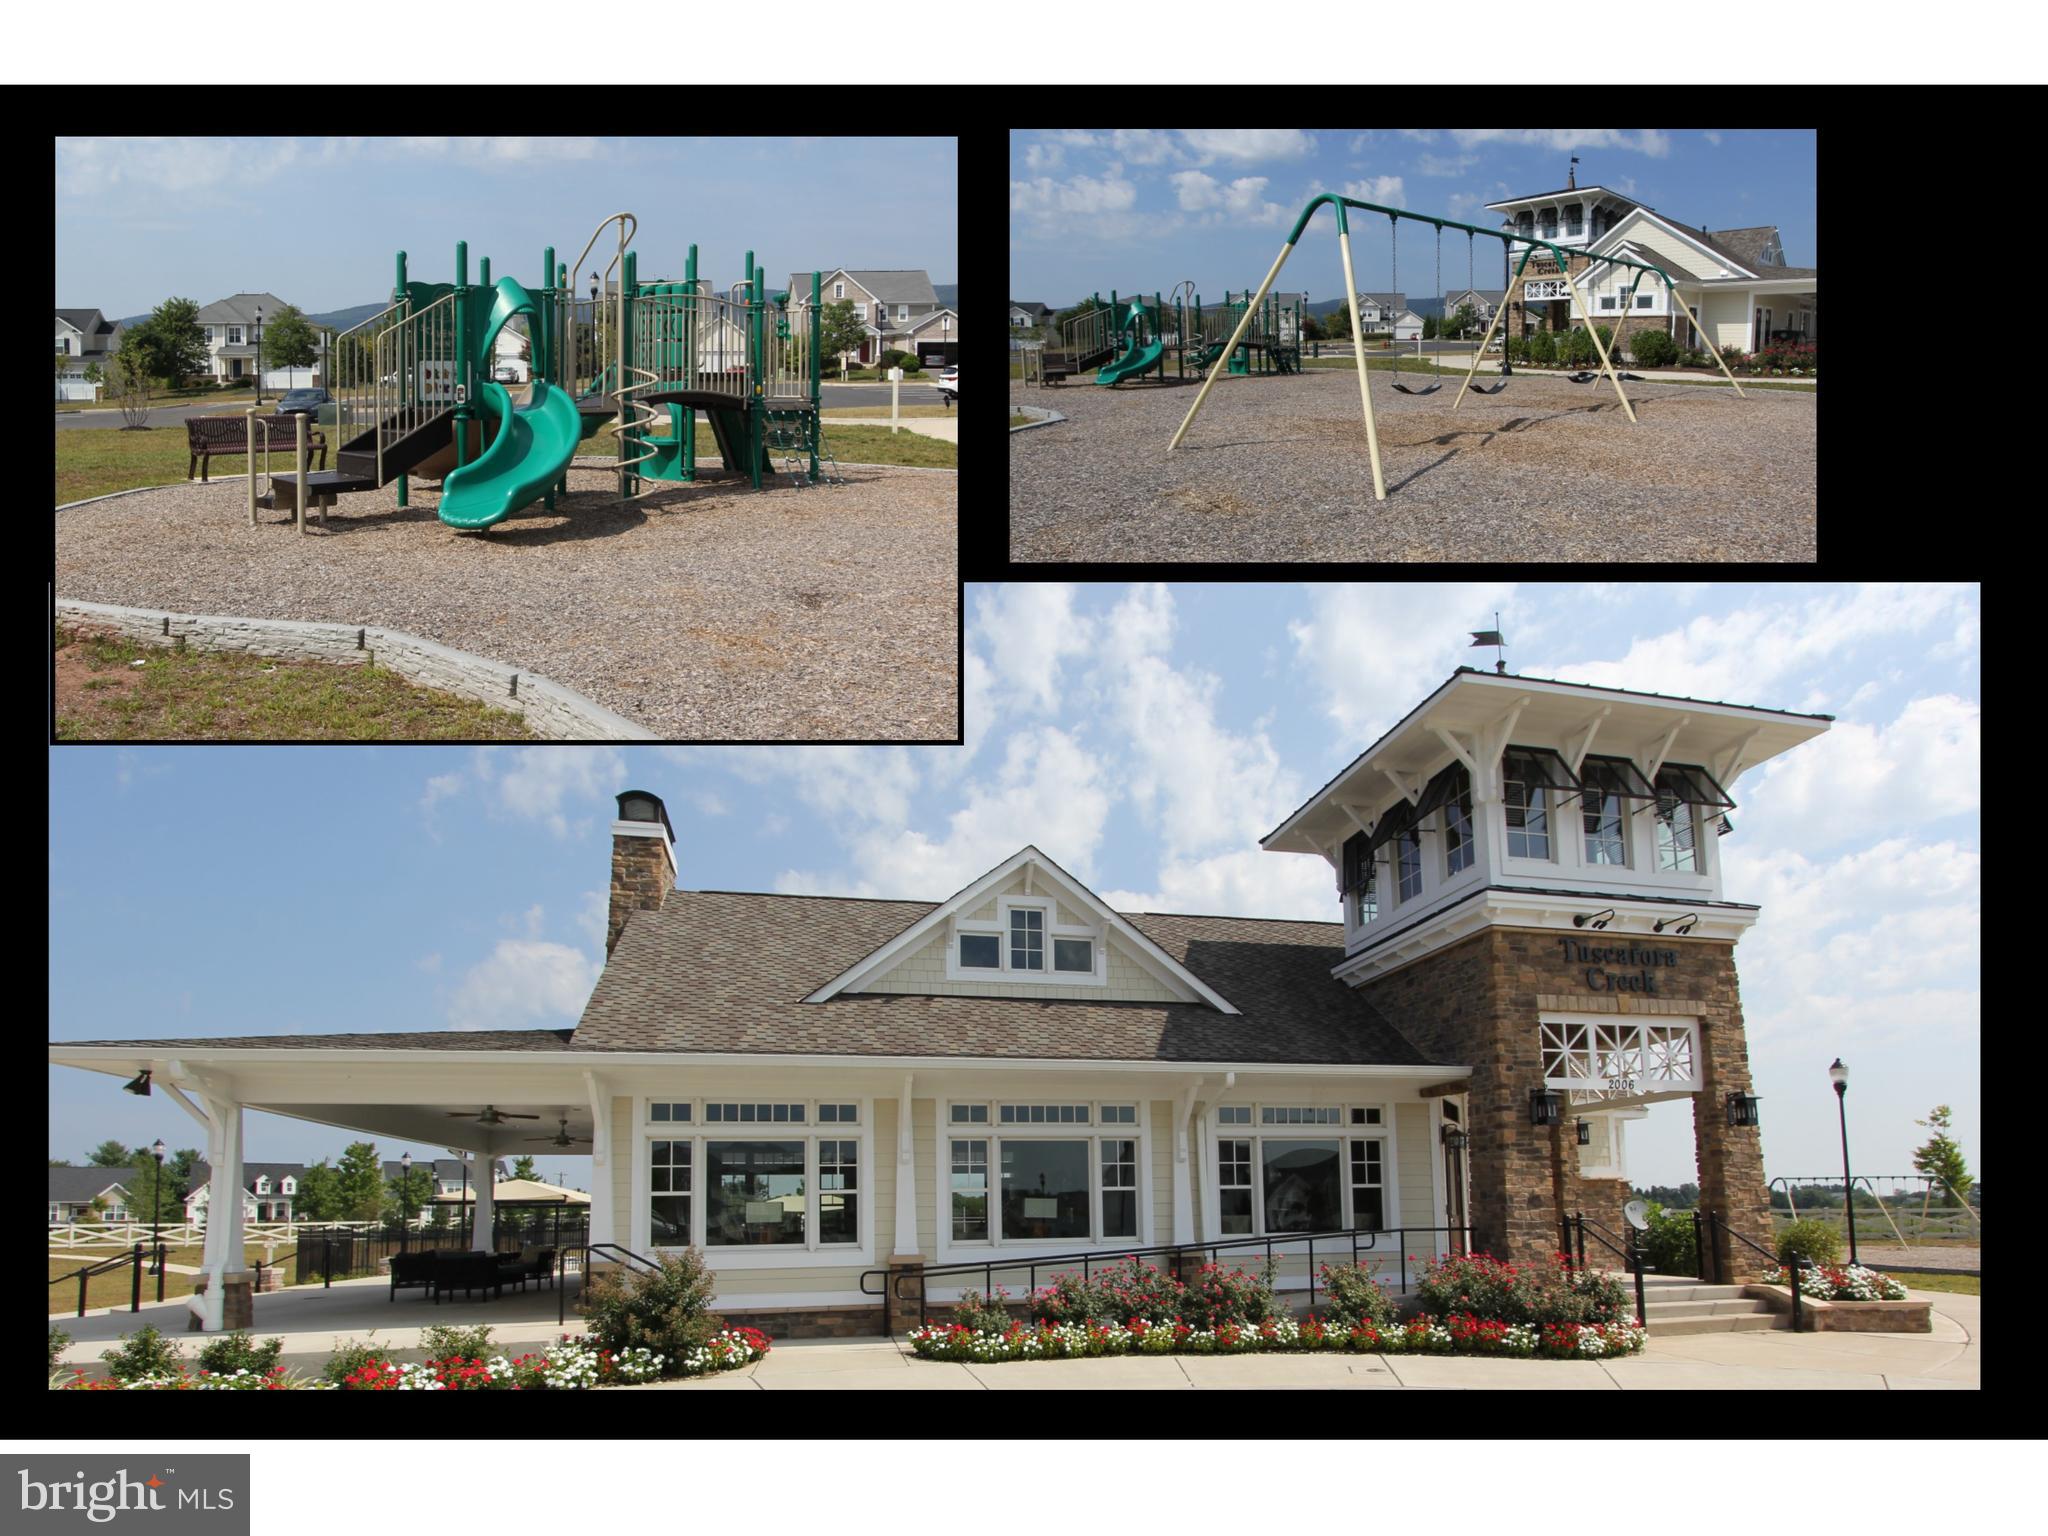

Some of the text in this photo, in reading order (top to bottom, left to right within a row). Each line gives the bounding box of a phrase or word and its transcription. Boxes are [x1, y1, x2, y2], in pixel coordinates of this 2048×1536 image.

[1558, 938, 1678, 967] Tuscarora
[1586, 967, 1656, 992] Creek
[1608, 1079, 1635, 1090] 2006
